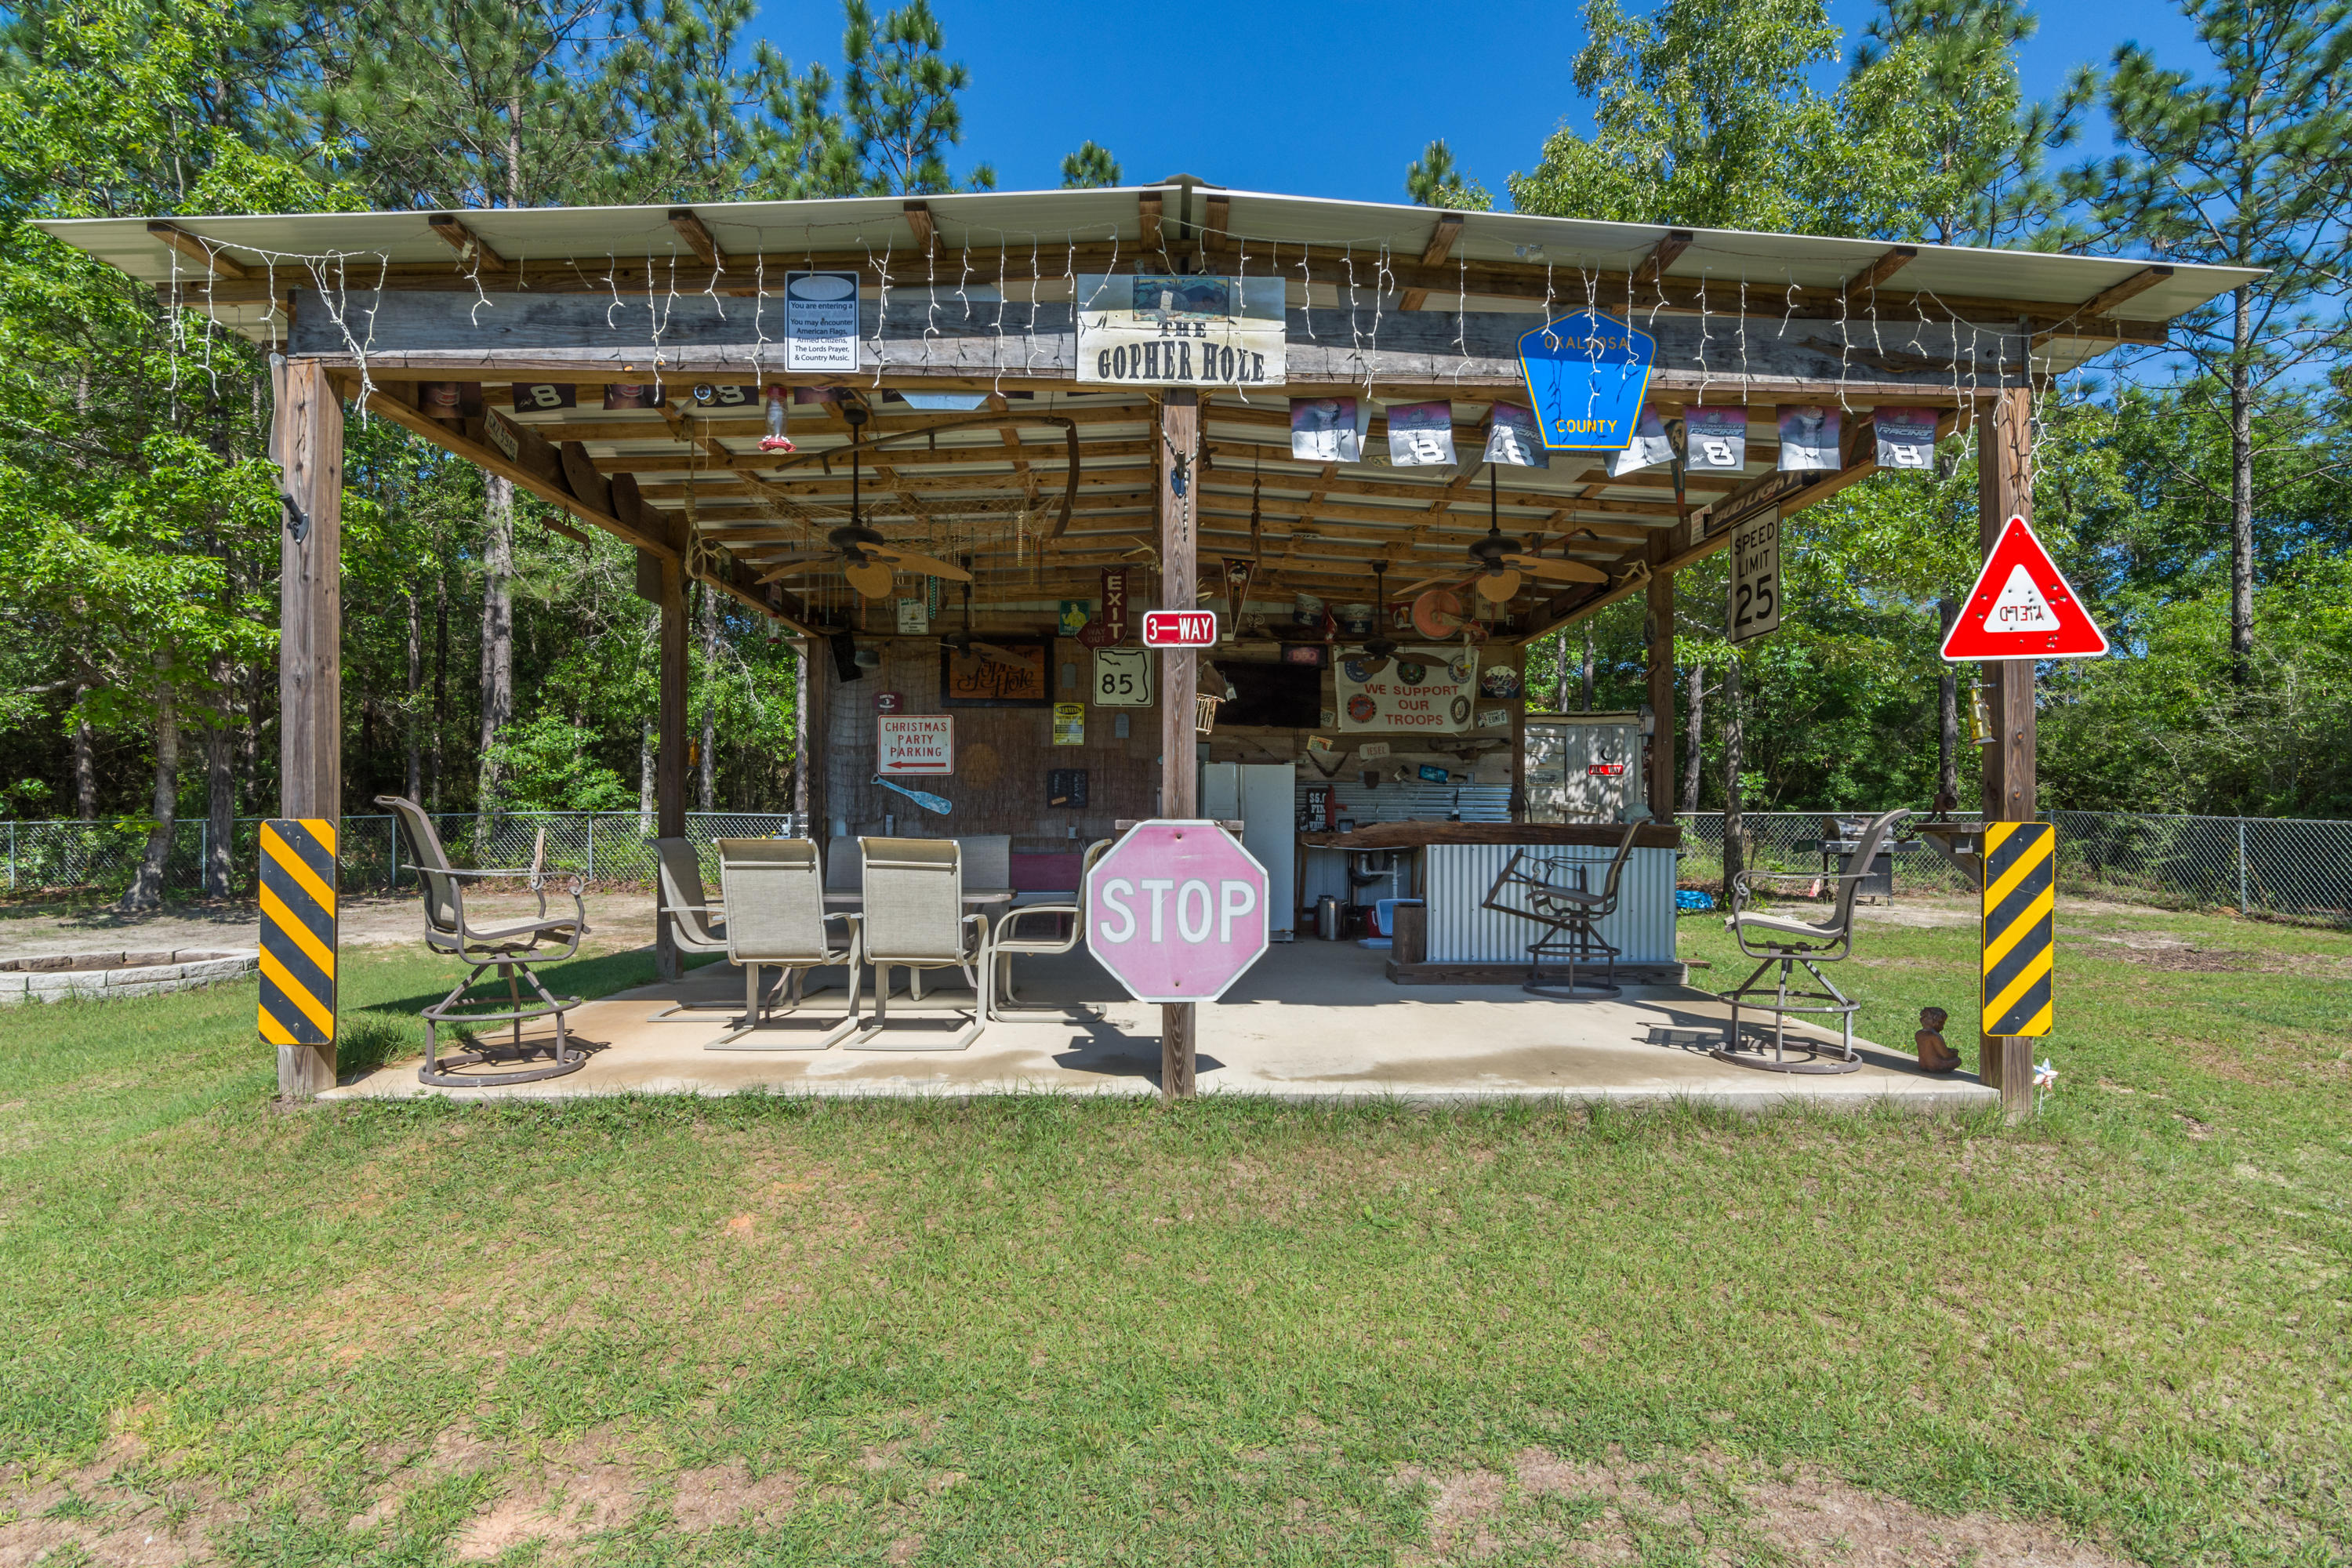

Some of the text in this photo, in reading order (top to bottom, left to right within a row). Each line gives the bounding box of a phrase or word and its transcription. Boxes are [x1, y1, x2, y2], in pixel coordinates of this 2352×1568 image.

[818, 302, 847, 310] entering
[1157, 321, 1207, 338] THE
[1544, 336, 1630, 350] OKALOOSA
[1098, 340, 1265, 383] GOPHER HOLE
[530, 384, 562, 407] 8
[1556, 419, 1617, 434] COUNTY
[1878, 427, 1933, 437] RACING
[1409, 438, 1446, 462] 8
[1504, 438, 1535, 466] 8
[1702, 441, 1737, 466] 8
[1890, 444, 1925, 466] 8
[1712, 499, 1745, 525] BUD
[1734, 522, 1775, 556] SPEED
[1738, 549, 1770, 579] LIMIT
[1107, 575, 1123, 639] EXIT
[1734, 573, 1774, 628] 25
[1999, 605, 2045, 622] YIELD
[1102, 673, 1134, 695] 85
[1364, 684, 1459, 697] WE SUPPORT
[1398, 699, 1429, 711] OUR
[885, 722, 947, 731] CHRISTMAS
[1385, 713, 1443, 726] TROOPS
[898, 735, 934, 744] PARTY
[890, 746, 942, 757] PARKING
[1311, 804, 1327, 814] FIN
[1100, 878, 1256, 944] STOP
